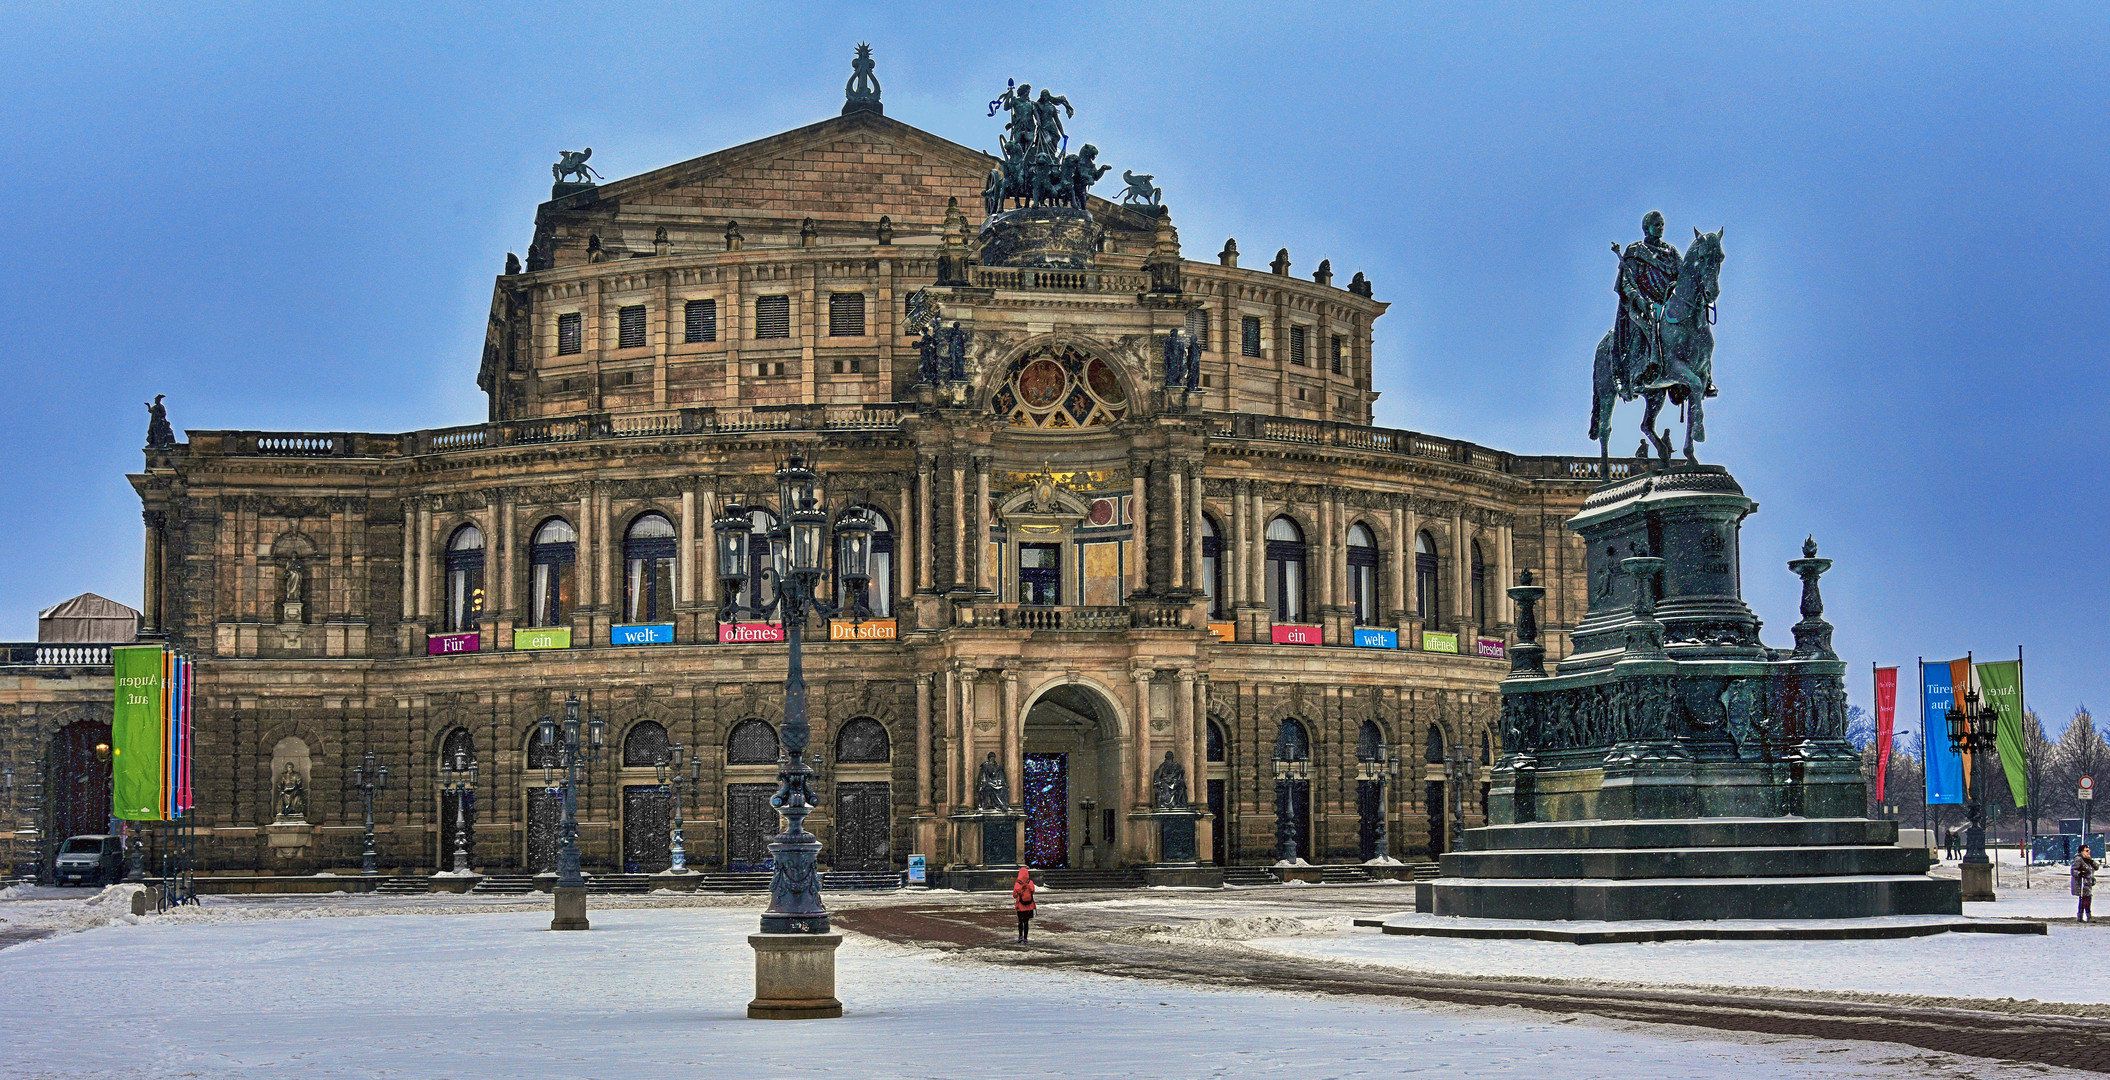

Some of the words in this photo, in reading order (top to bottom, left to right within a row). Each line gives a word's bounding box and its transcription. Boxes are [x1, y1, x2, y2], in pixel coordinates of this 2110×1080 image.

[532, 633, 552, 648] ein
[625, 628, 659, 643] welt-
[725, 626, 778, 641] offenes
[1288, 629, 1306, 643] ein
[1363, 633, 1388, 647] welt-
[443, 638, 465, 652] Für
[1426, 637, 1455, 651] offenes
[1478, 642, 1504, 657] Dresden
